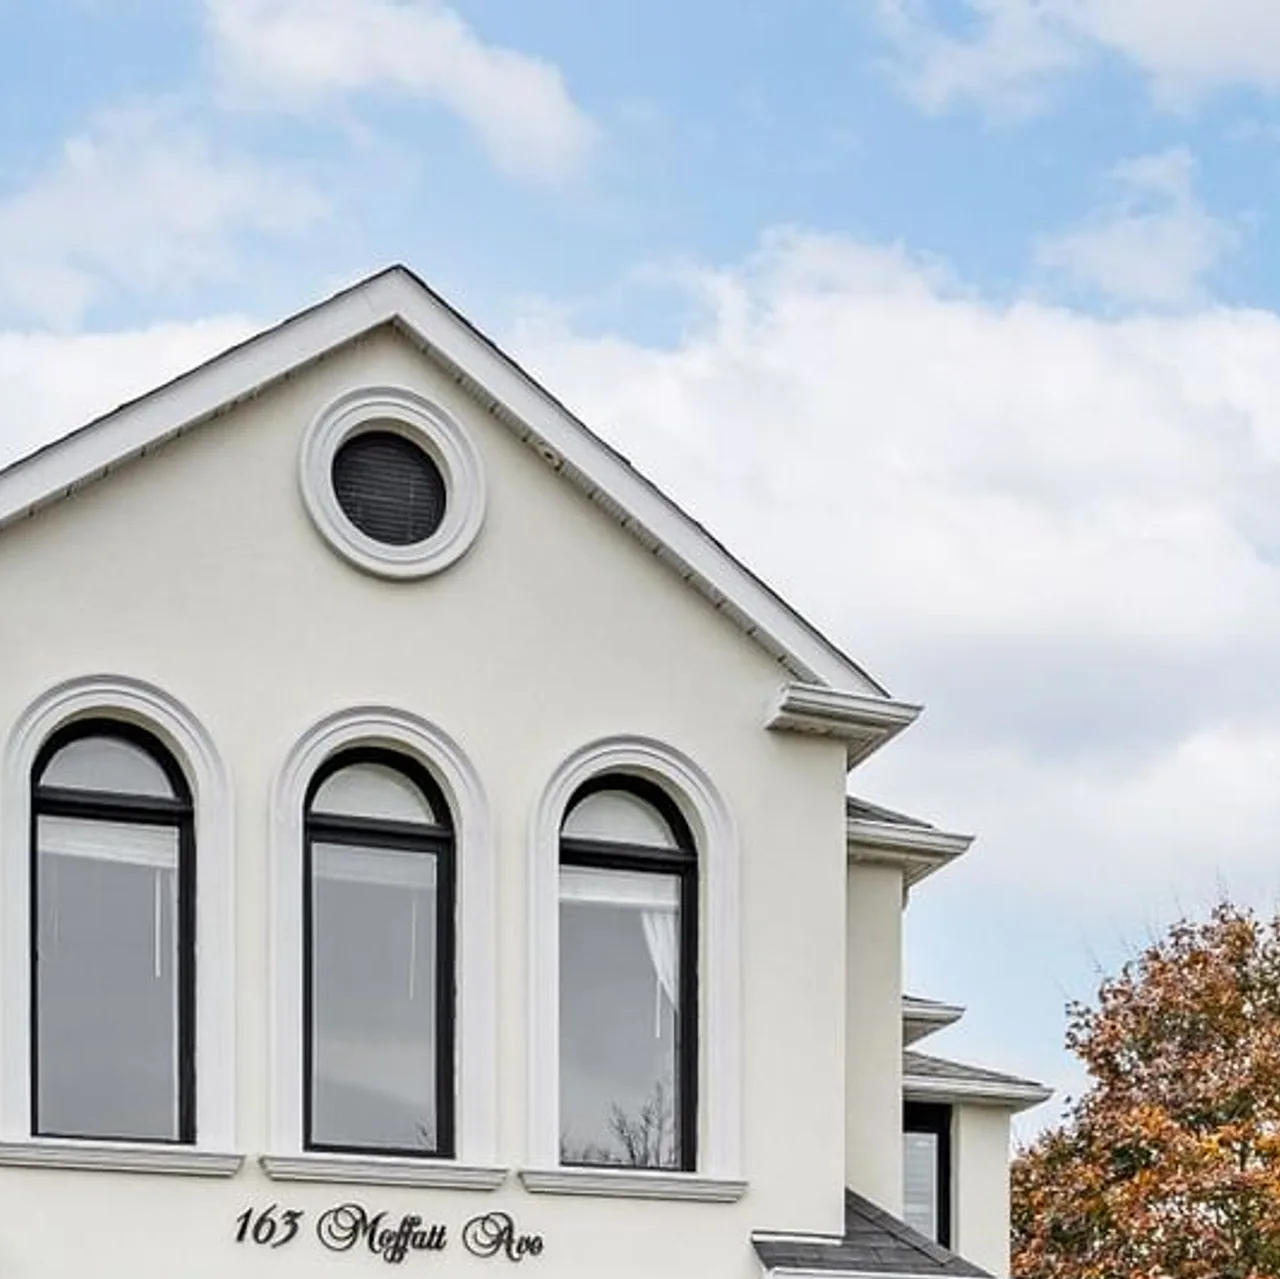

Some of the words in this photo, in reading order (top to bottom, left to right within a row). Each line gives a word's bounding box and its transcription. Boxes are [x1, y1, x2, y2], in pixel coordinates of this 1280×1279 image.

[234, 1203, 305, 1249] 163
[316, 1202, 448, 1264] Moffatt
[461, 1211, 544, 1262] Ave
